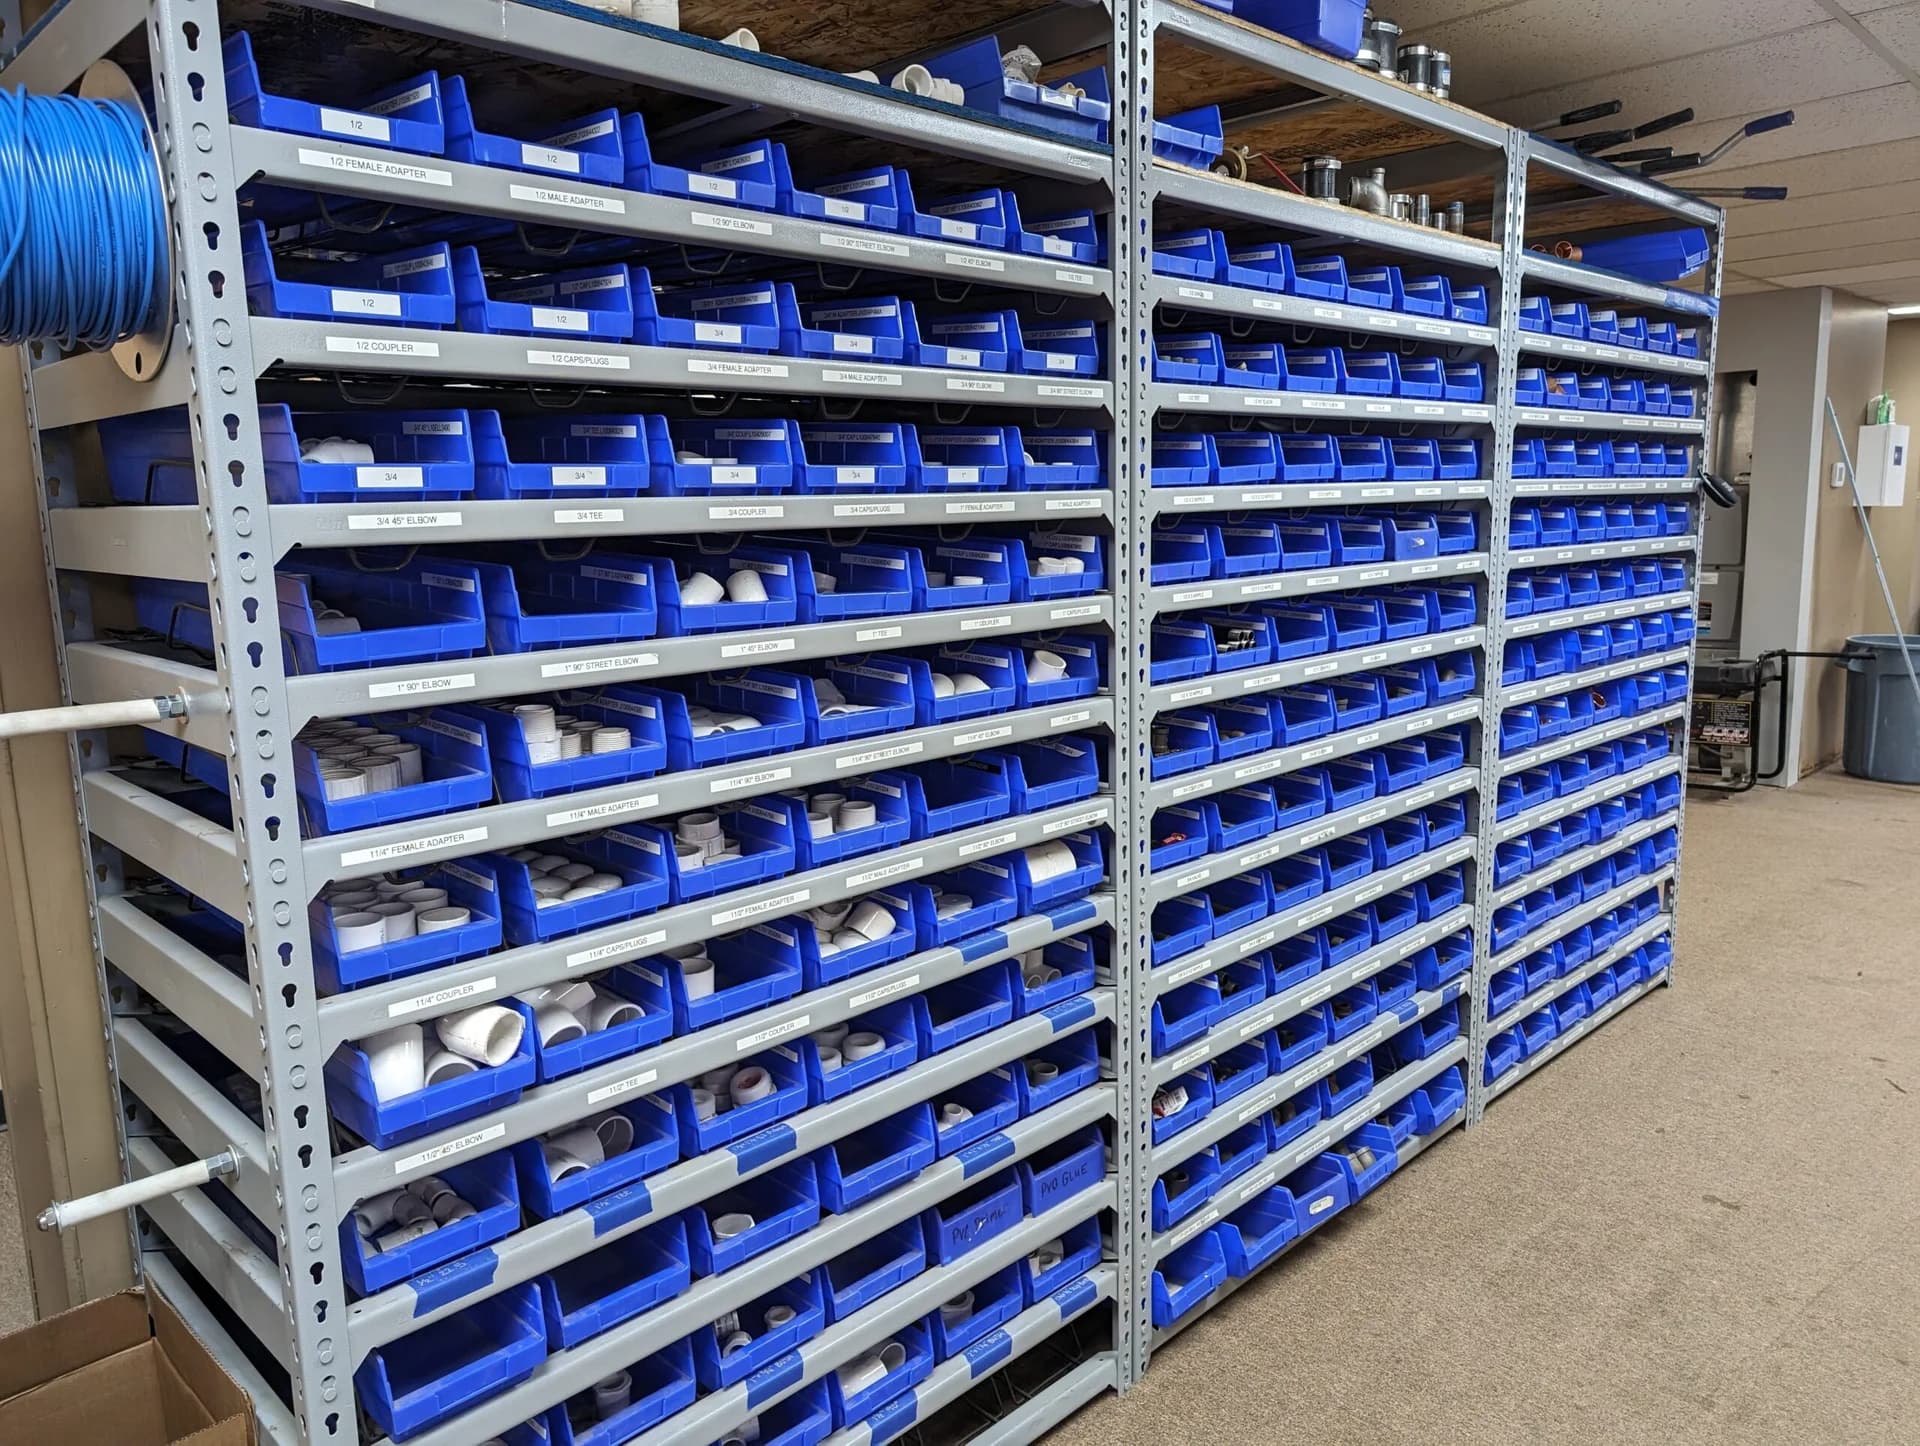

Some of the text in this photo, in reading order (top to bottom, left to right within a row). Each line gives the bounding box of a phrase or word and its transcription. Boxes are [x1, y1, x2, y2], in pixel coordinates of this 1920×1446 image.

[350, 120, 363, 130] 1/2
[546, 151, 558, 163] 1/2
[330, 157, 428, 179] 1/2 FEMALE ADAPTER
[708, 181, 718, 190] 1/2
[535, 191, 604, 208] 1/2 MALE ADAPTER
[841, 206, 850, 214] 1/2
[712, 217, 721, 225] 1/2
[732, 220, 755, 230] ELBOW
[361, 298, 374, 308] 1/2
[556, 315, 568, 323] 1/2
[714, 329, 724, 337] 3/4
[356, 341, 414, 352] 1/2 COUPLER
[551, 354, 609, 365] 1/2 CAPS/PLUGS
[707, 362, 771, 374] 3/4 FEMALE ADAPTER
[839, 372, 887, 382] 3/4 MALE ADAPTER
[384, 472, 397, 481] 3/4
[575, 472, 586, 480] 3/4
[851, 469, 861, 479] 3/4
[576, 511, 603, 520] 3/4 TEE
[727, 507, 766, 516] 3/4 COUPLER
[376, 517, 389, 525] 3/4
[406, 515, 437, 524] ELBOW
[757, 642, 778, 651] ELBOW
[585, 660, 614, 671] STREET
[614, 657, 640, 668] ELBOW
[421, 679, 451, 689] ELBOW
[754, 772, 775, 782] ELBOW
[587, 806, 606, 816] MALE
[607, 799, 639, 812] ADAPTER
[391, 840, 425, 854] FEMALE
[426, 833, 464, 847] ADAPTER
[605, 936, 648, 954] CAPS/PLUGS
[435, 984, 474, 1002] COUPLER
[626, 1078, 639, 1089] TEE
[455, 1133, 483, 1149] ELBOW
